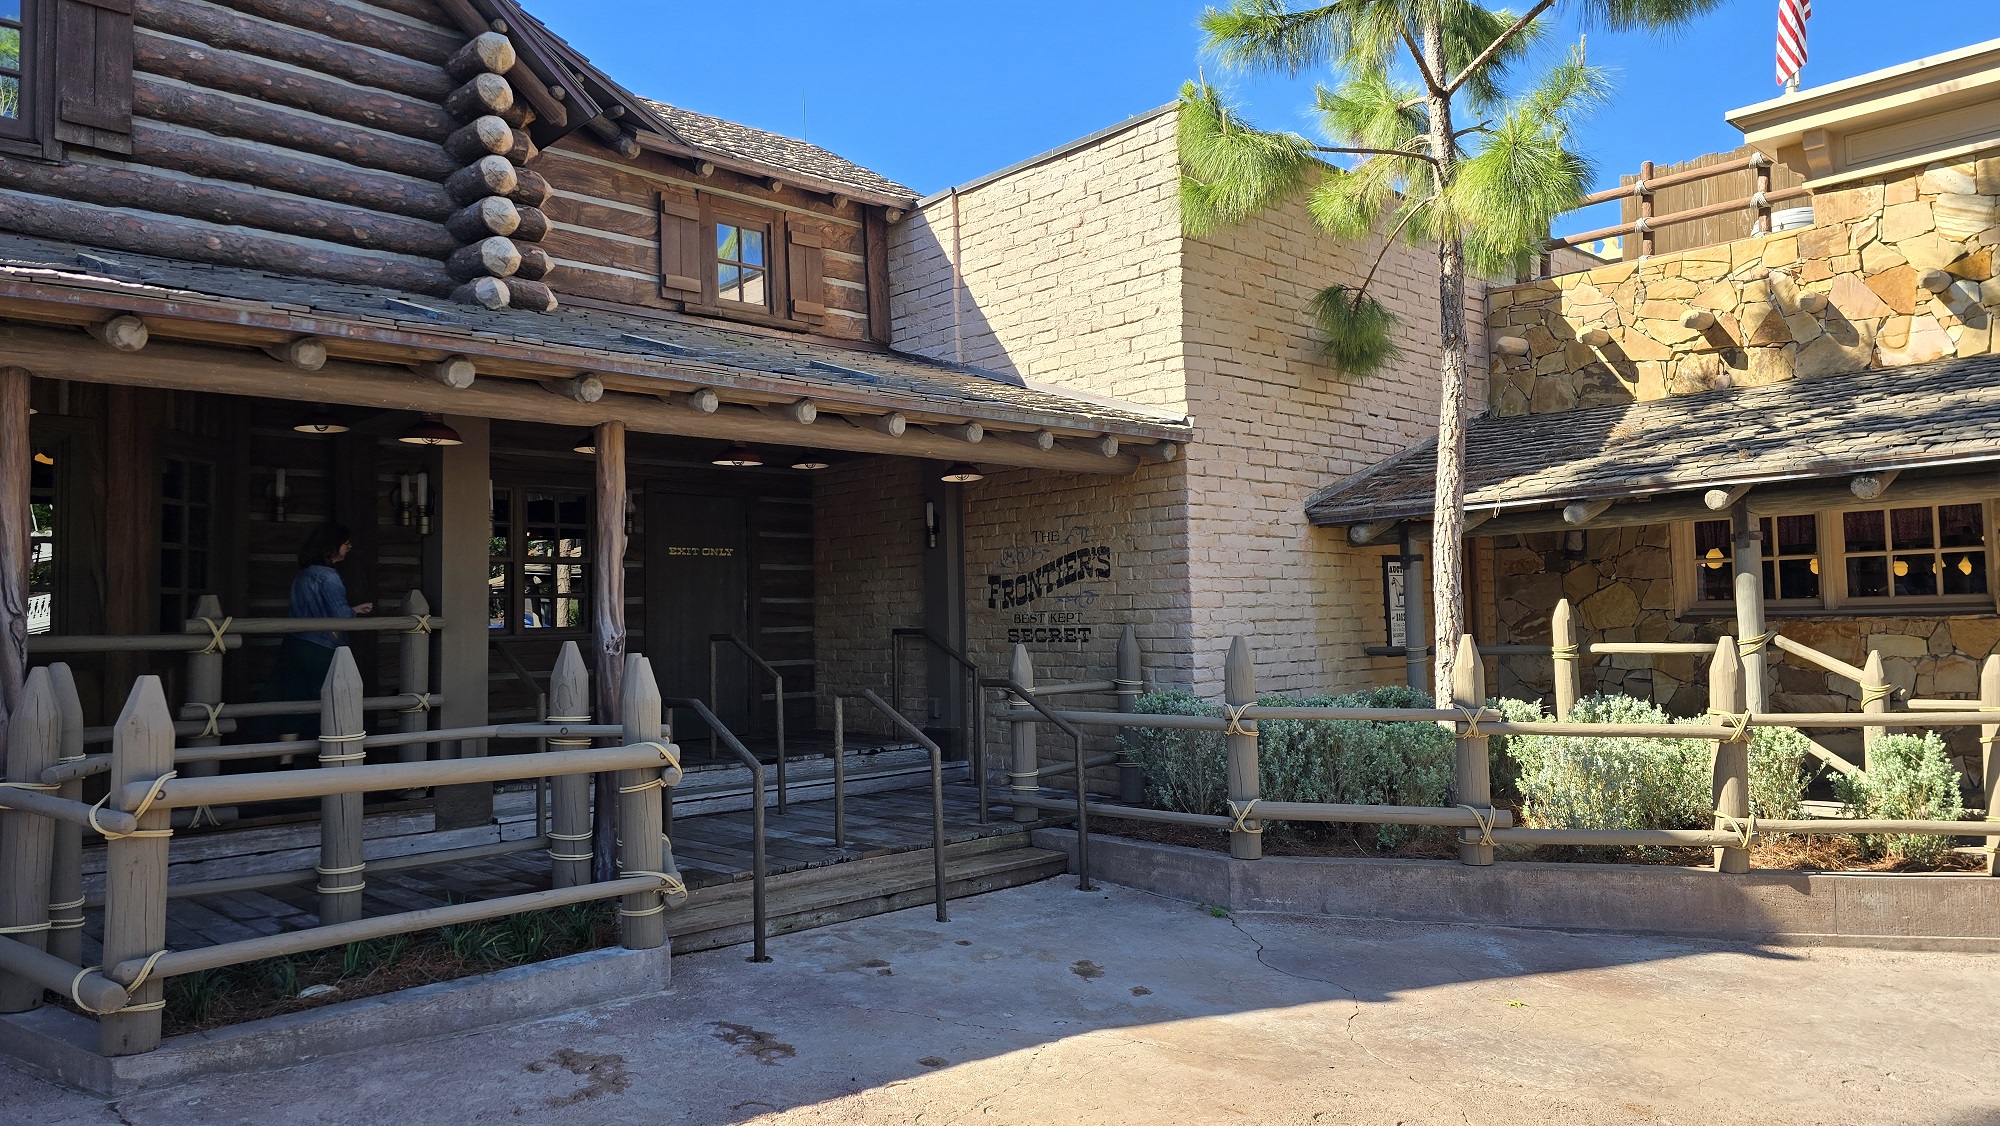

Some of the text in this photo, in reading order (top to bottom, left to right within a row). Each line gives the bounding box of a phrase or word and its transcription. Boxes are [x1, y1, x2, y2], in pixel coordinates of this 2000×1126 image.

[1032, 531, 1060, 543] THE
[668, 546, 733, 557] EXIT ONLY
[987, 545, 1111, 610] FRONTIER'S
[1013, 612, 1084, 624] BEST KEPT
[1007, 627, 1092, 643] SECRET
